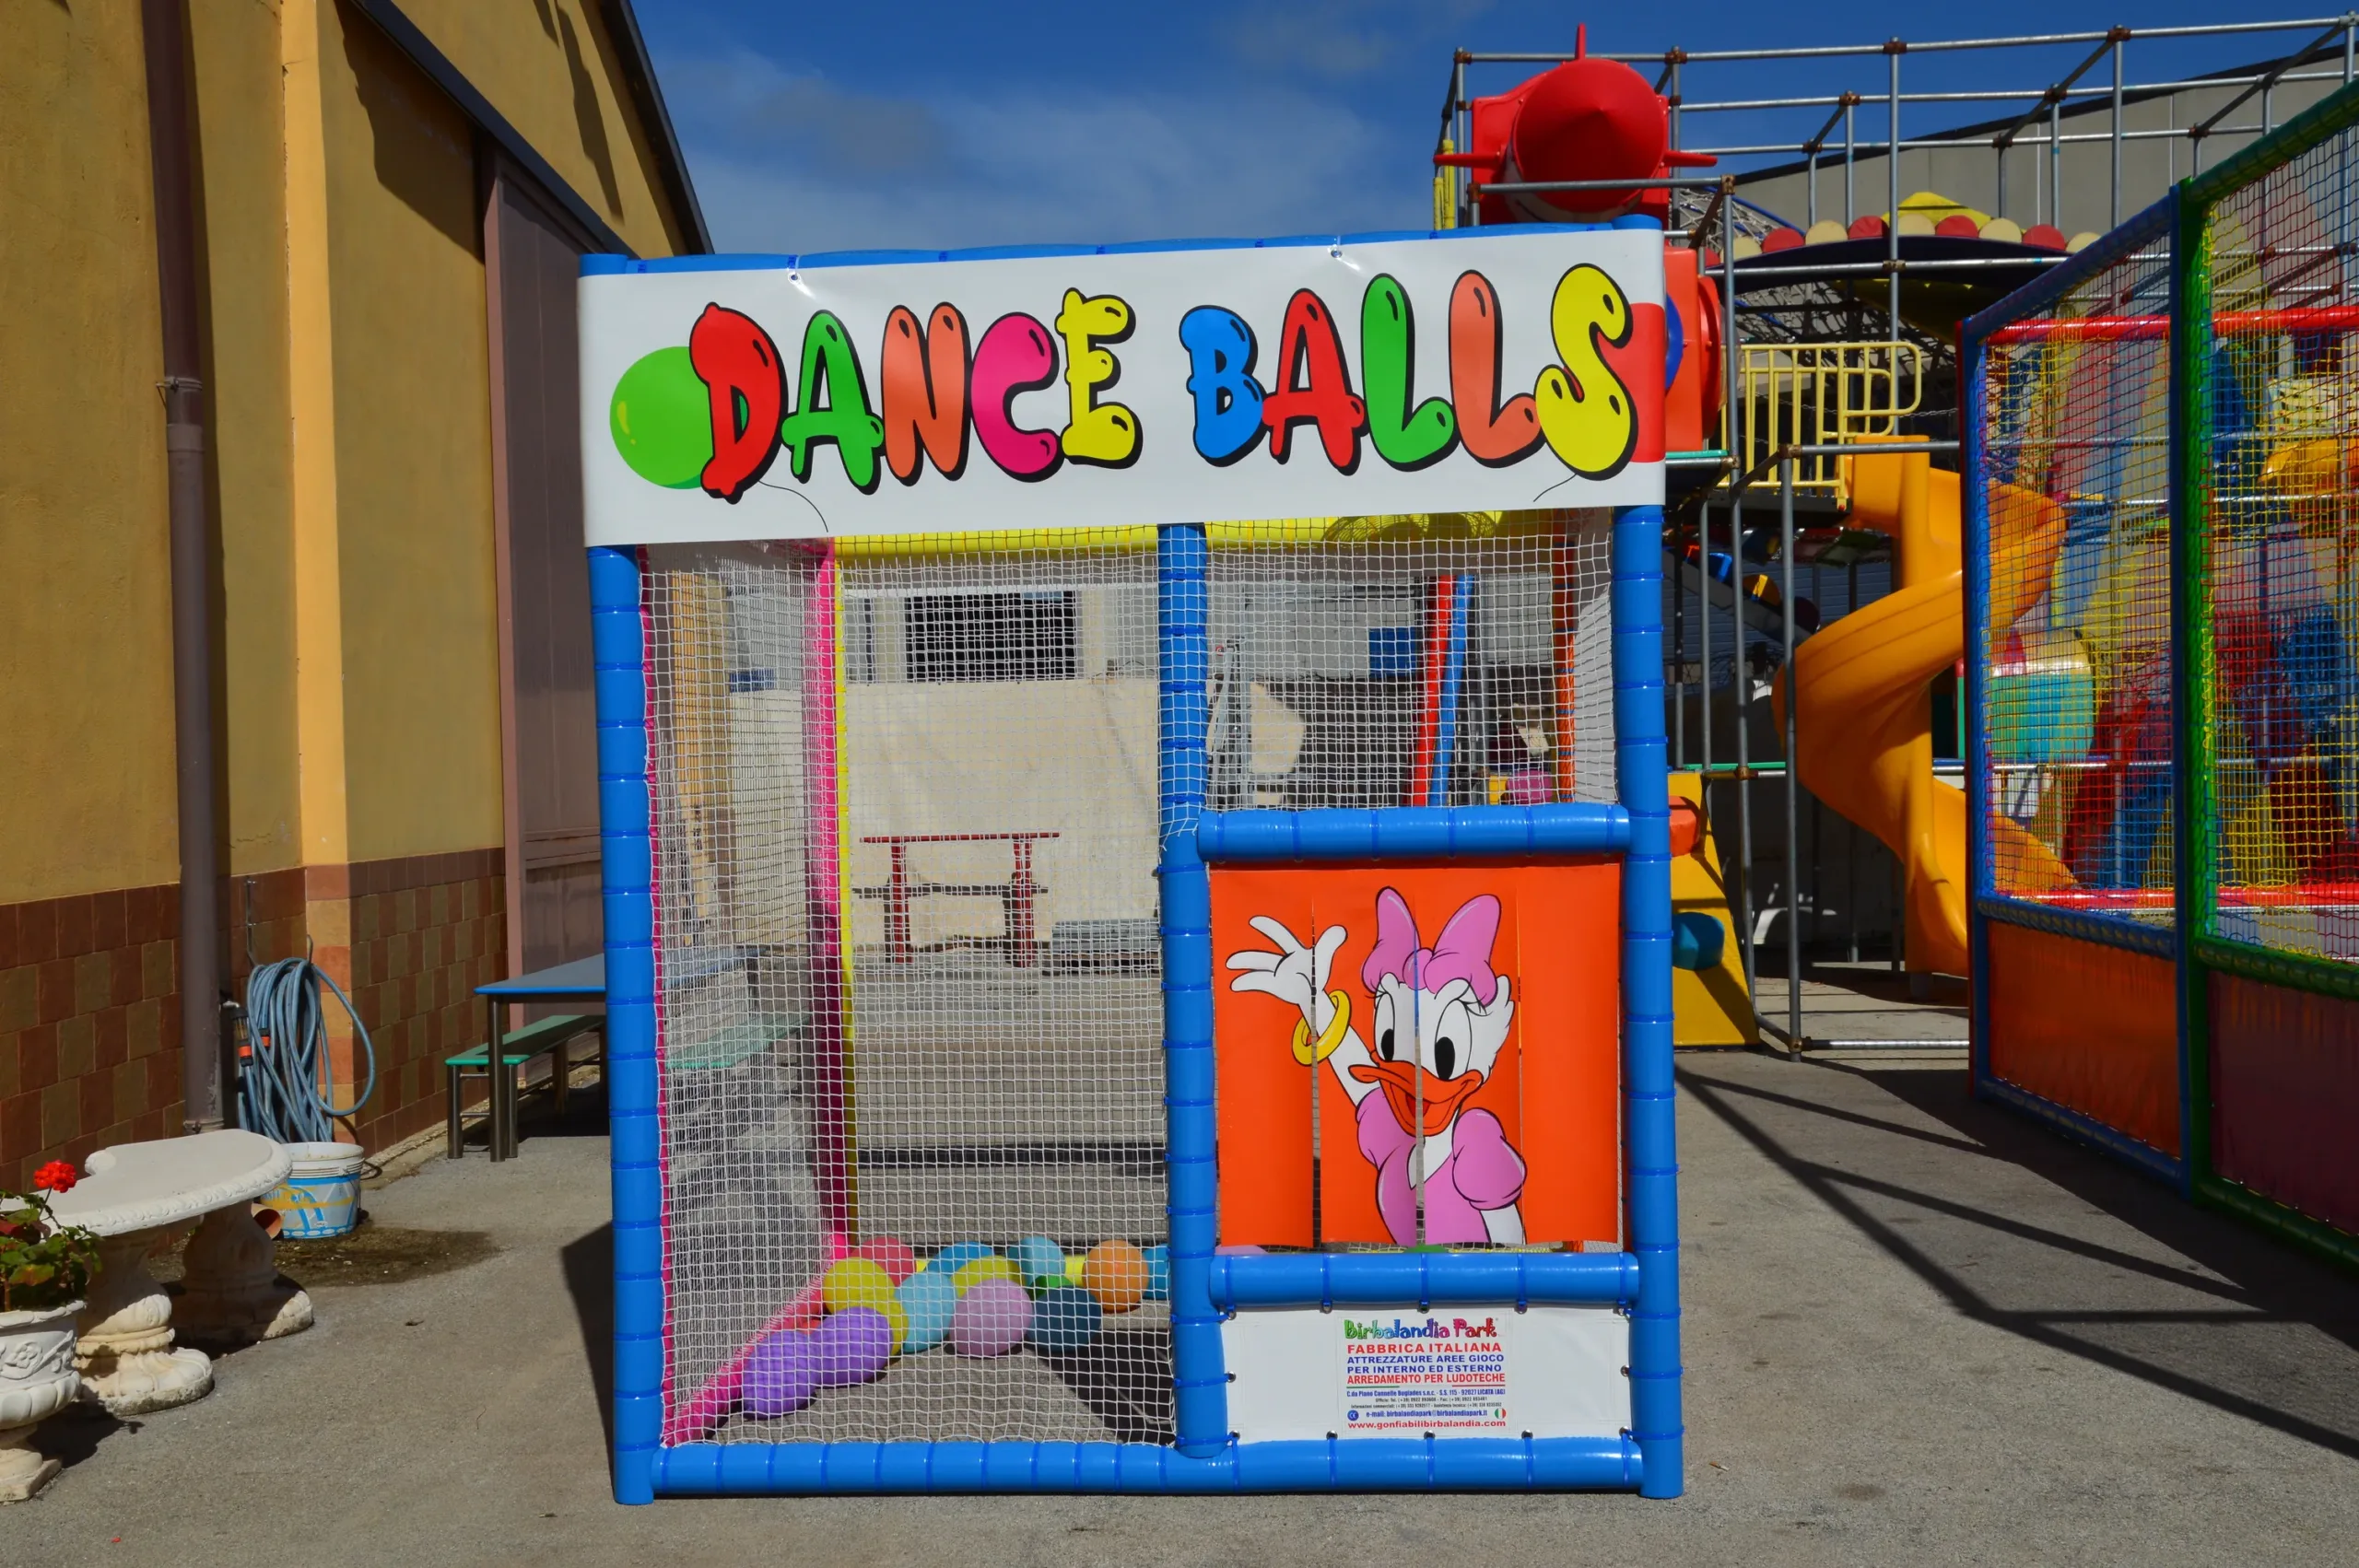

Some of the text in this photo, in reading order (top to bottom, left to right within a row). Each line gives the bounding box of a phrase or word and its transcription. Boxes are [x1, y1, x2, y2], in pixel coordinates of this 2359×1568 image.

[688, 263, 1636, 504] DANCE BALLS
[1344, 1316, 1497, 1340] Birbalandia Park
[1347, 1342, 1502, 1354] FABBRICA ITALIANA
[1347, 1353, 1505, 1364] ATTREZZATURE AREE GIOCO
[1347, 1363, 1502, 1375] PER INTERNO ED ESTERNO
[1347, 1373, 1506, 1385] ARREDAMENTO PER LUDOTECHE
[1347, 1420, 1506, 1431] www.gonfiabilibirbalandia.com
